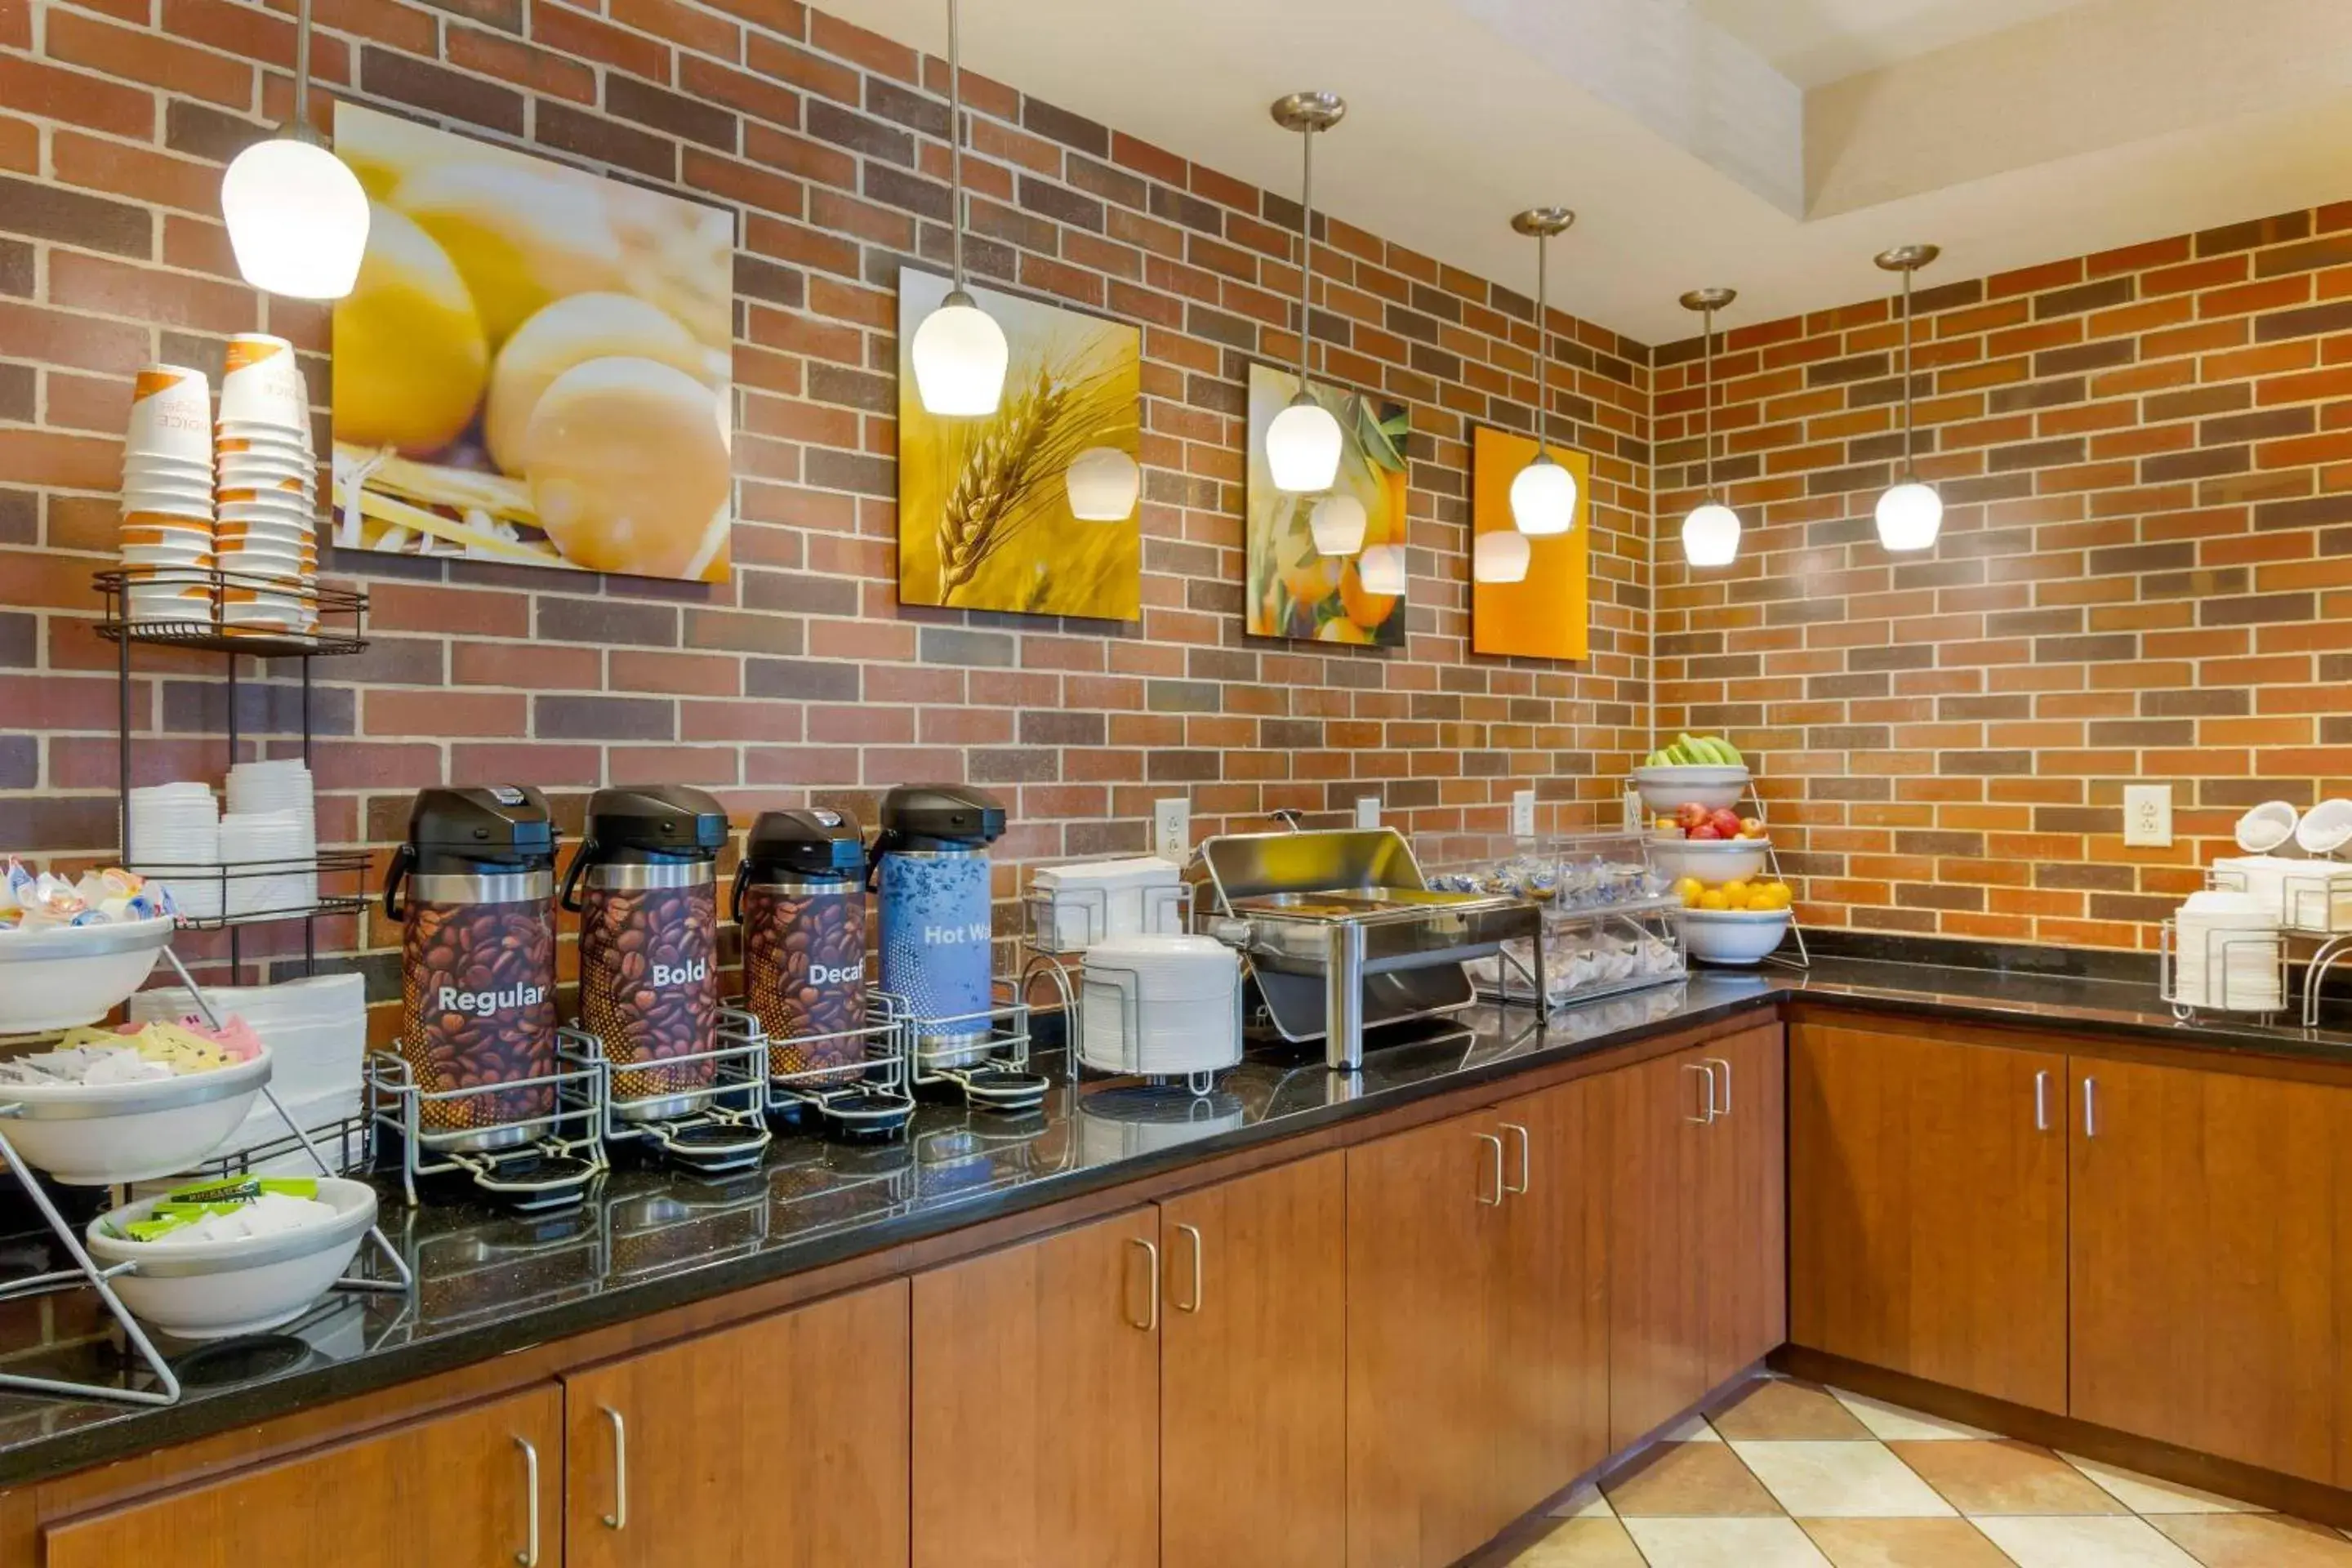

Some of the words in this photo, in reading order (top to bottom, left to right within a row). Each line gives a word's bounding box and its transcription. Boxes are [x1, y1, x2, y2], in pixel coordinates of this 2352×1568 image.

[924, 925, 965, 944] Hot
[653, 956, 706, 987] Bold
[809, 957, 864, 985] Decaf
[439, 982, 545, 1017] Regular
